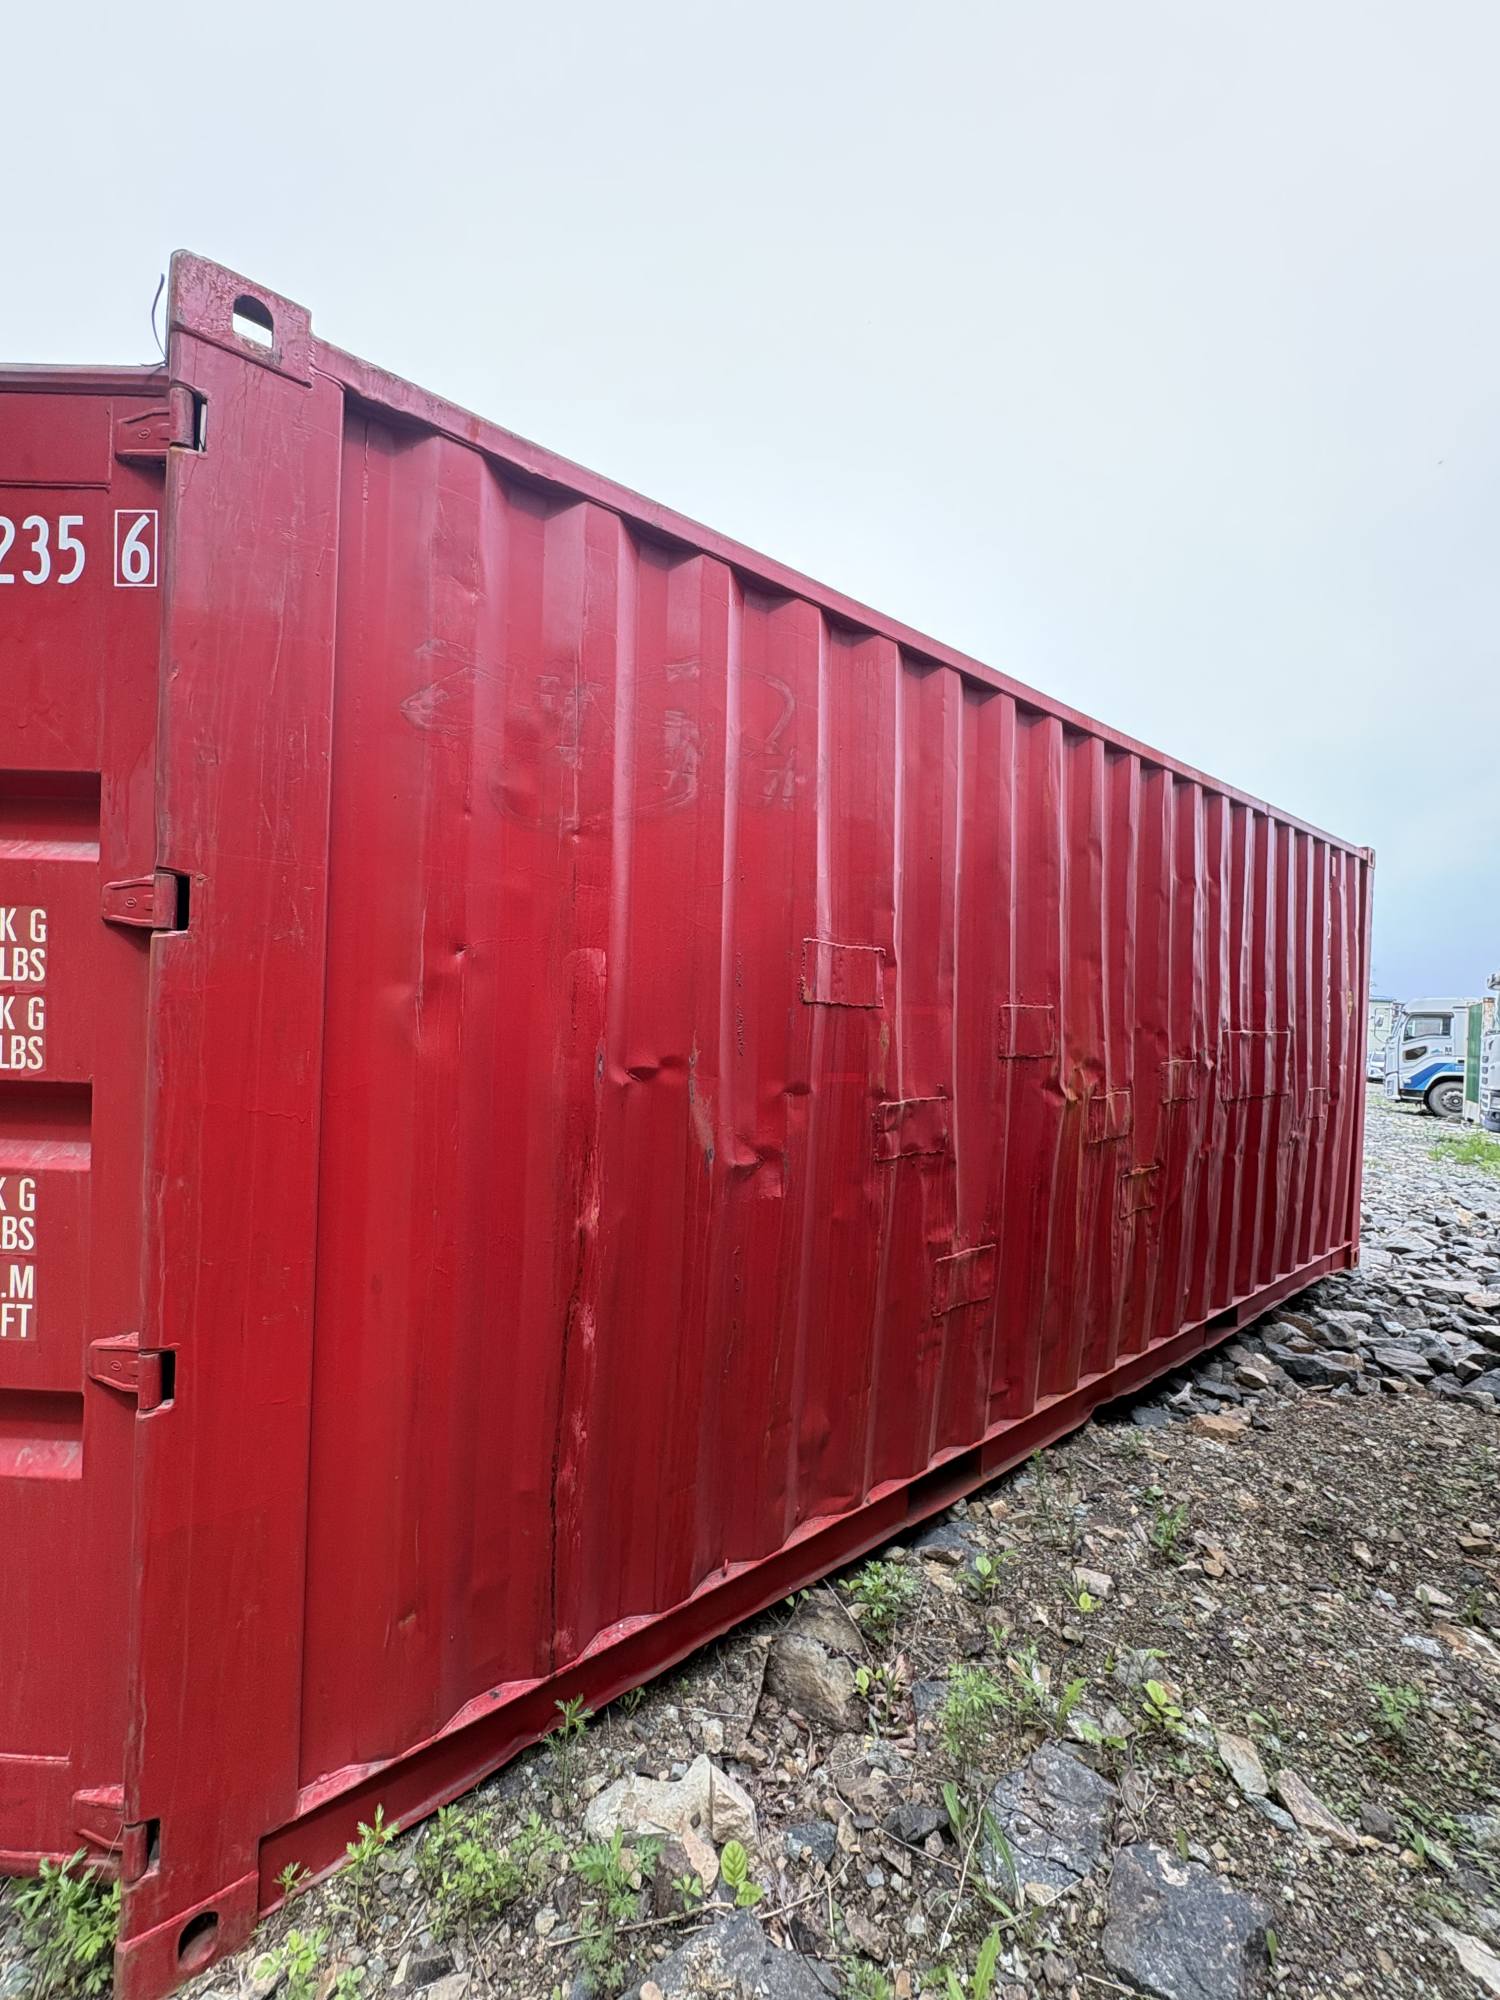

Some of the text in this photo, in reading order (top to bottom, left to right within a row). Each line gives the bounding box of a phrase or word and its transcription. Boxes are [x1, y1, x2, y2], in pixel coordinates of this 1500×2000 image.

[121, 513, 151, 583] 6
[0, 947, 46, 982] LBS
[0, 1035, 43, 1070] LBS
[0, 1216, 35, 1250] BS
[0, 1303, 33, 1338] FT
